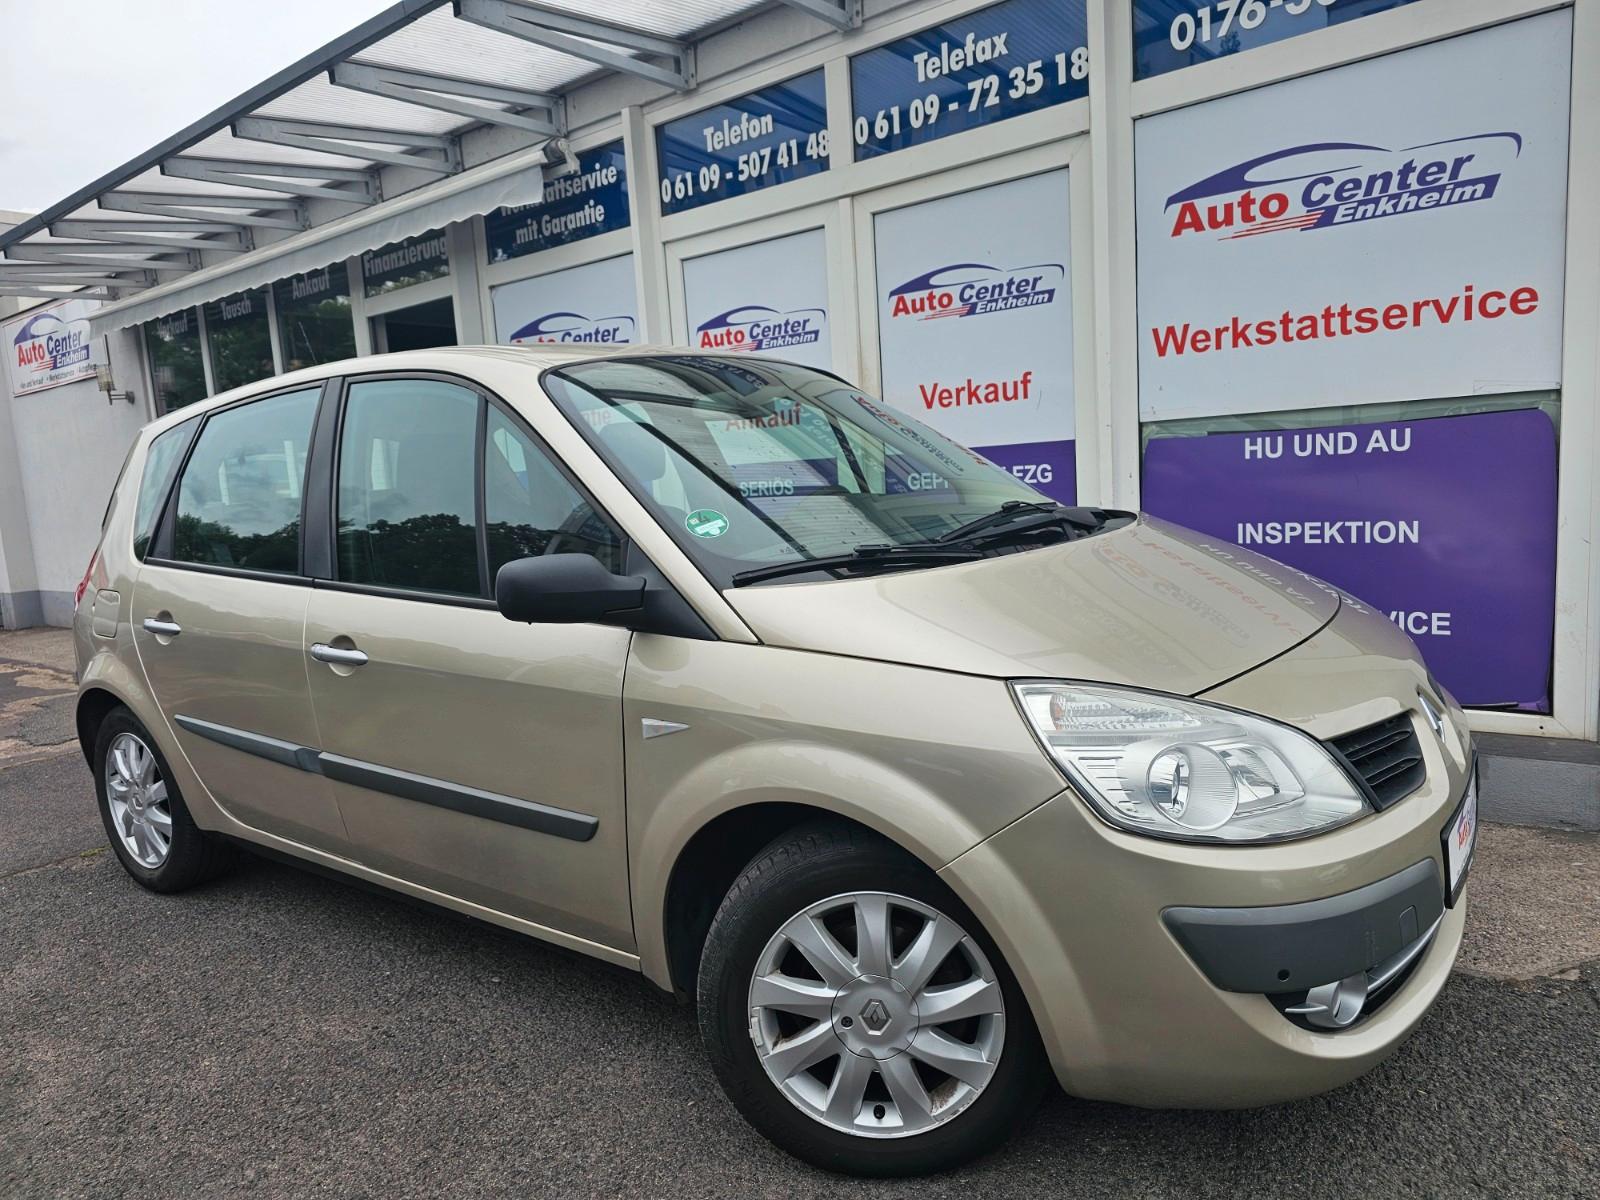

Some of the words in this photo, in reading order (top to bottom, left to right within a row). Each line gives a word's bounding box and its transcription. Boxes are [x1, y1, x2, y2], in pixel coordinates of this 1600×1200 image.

[913, 32, 1009, 83] Telefax
[909, 93, 940, 129] 09
[967, 74, 1000, 112] 72
[1008, 60, 1043, 99] 35
[1055, 47, 1089, 85] 18
[703, 112, 773, 153] Telefon
[699, 164, 720, 193] 09
[738, 147, 771, 182] 507
[777, 140, 798, 168] 41
[806, 130, 830, 158] 48
[1171, 190, 1289, 237] Auto
[1300, 153, 1475, 209] Center
[1332, 181, 1486, 223] Enkheim
[541, 200, 605, 237] Garantie
[364, 236, 449, 278] Finanzierung
[292, 270, 331, 300] Ankauf
[892, 290, 953, 318] Auto
[959, 275, 1043, 303] Center
[975, 292, 1049, 314] Enkheim
[220, 292, 251, 321] Tausch
[1152, 284, 1539, 358] Werkstattservice
[18, 341, 46, 367] Auto
[46, 330, 82, 355] Center
[700, 330, 745, 349] Auto
[749, 316, 810, 341] Center
[761, 332, 816, 350] Enkheim
[56, 348, 87, 364] Enkheim
[919, 371, 1032, 410] Verkauf
[1243, 436, 1283, 460] HU
[1293, 431, 1358, 457] UND
[1365, 427, 1412, 454] AU
[1237, 519, 1420, 544] INSPEKTION
